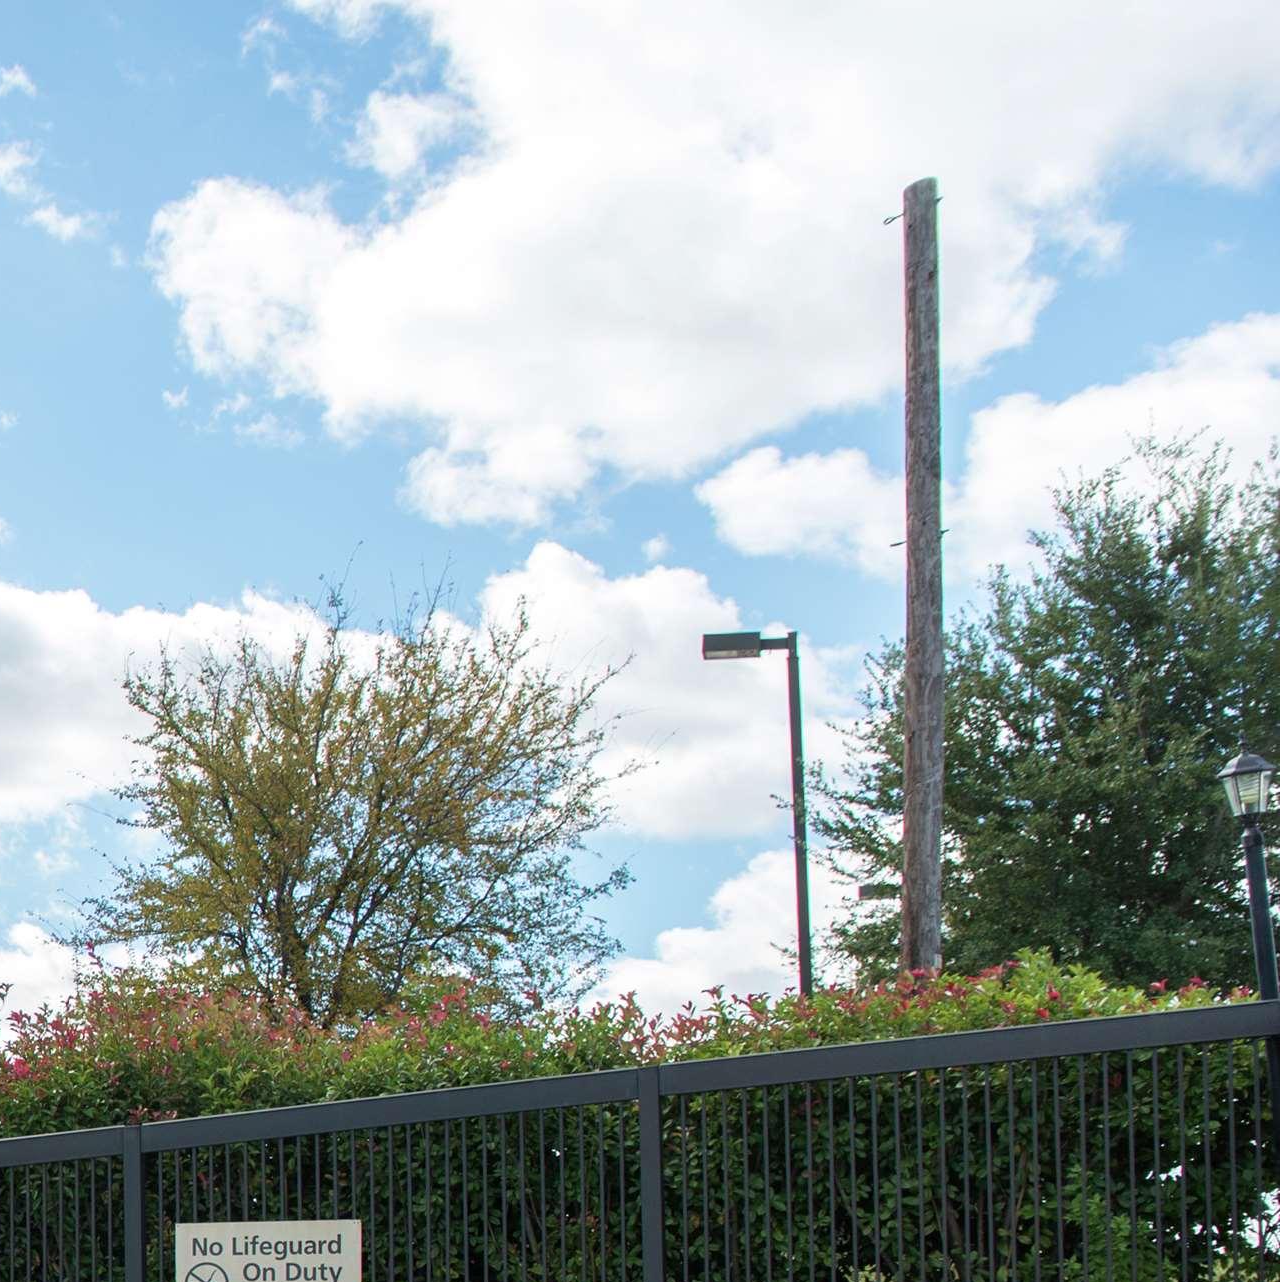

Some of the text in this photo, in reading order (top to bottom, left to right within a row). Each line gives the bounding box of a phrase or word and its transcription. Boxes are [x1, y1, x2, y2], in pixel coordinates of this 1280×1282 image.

[192, 1234, 342, 1261] No Lifeguard
[242, 1263, 276, 1282] On
